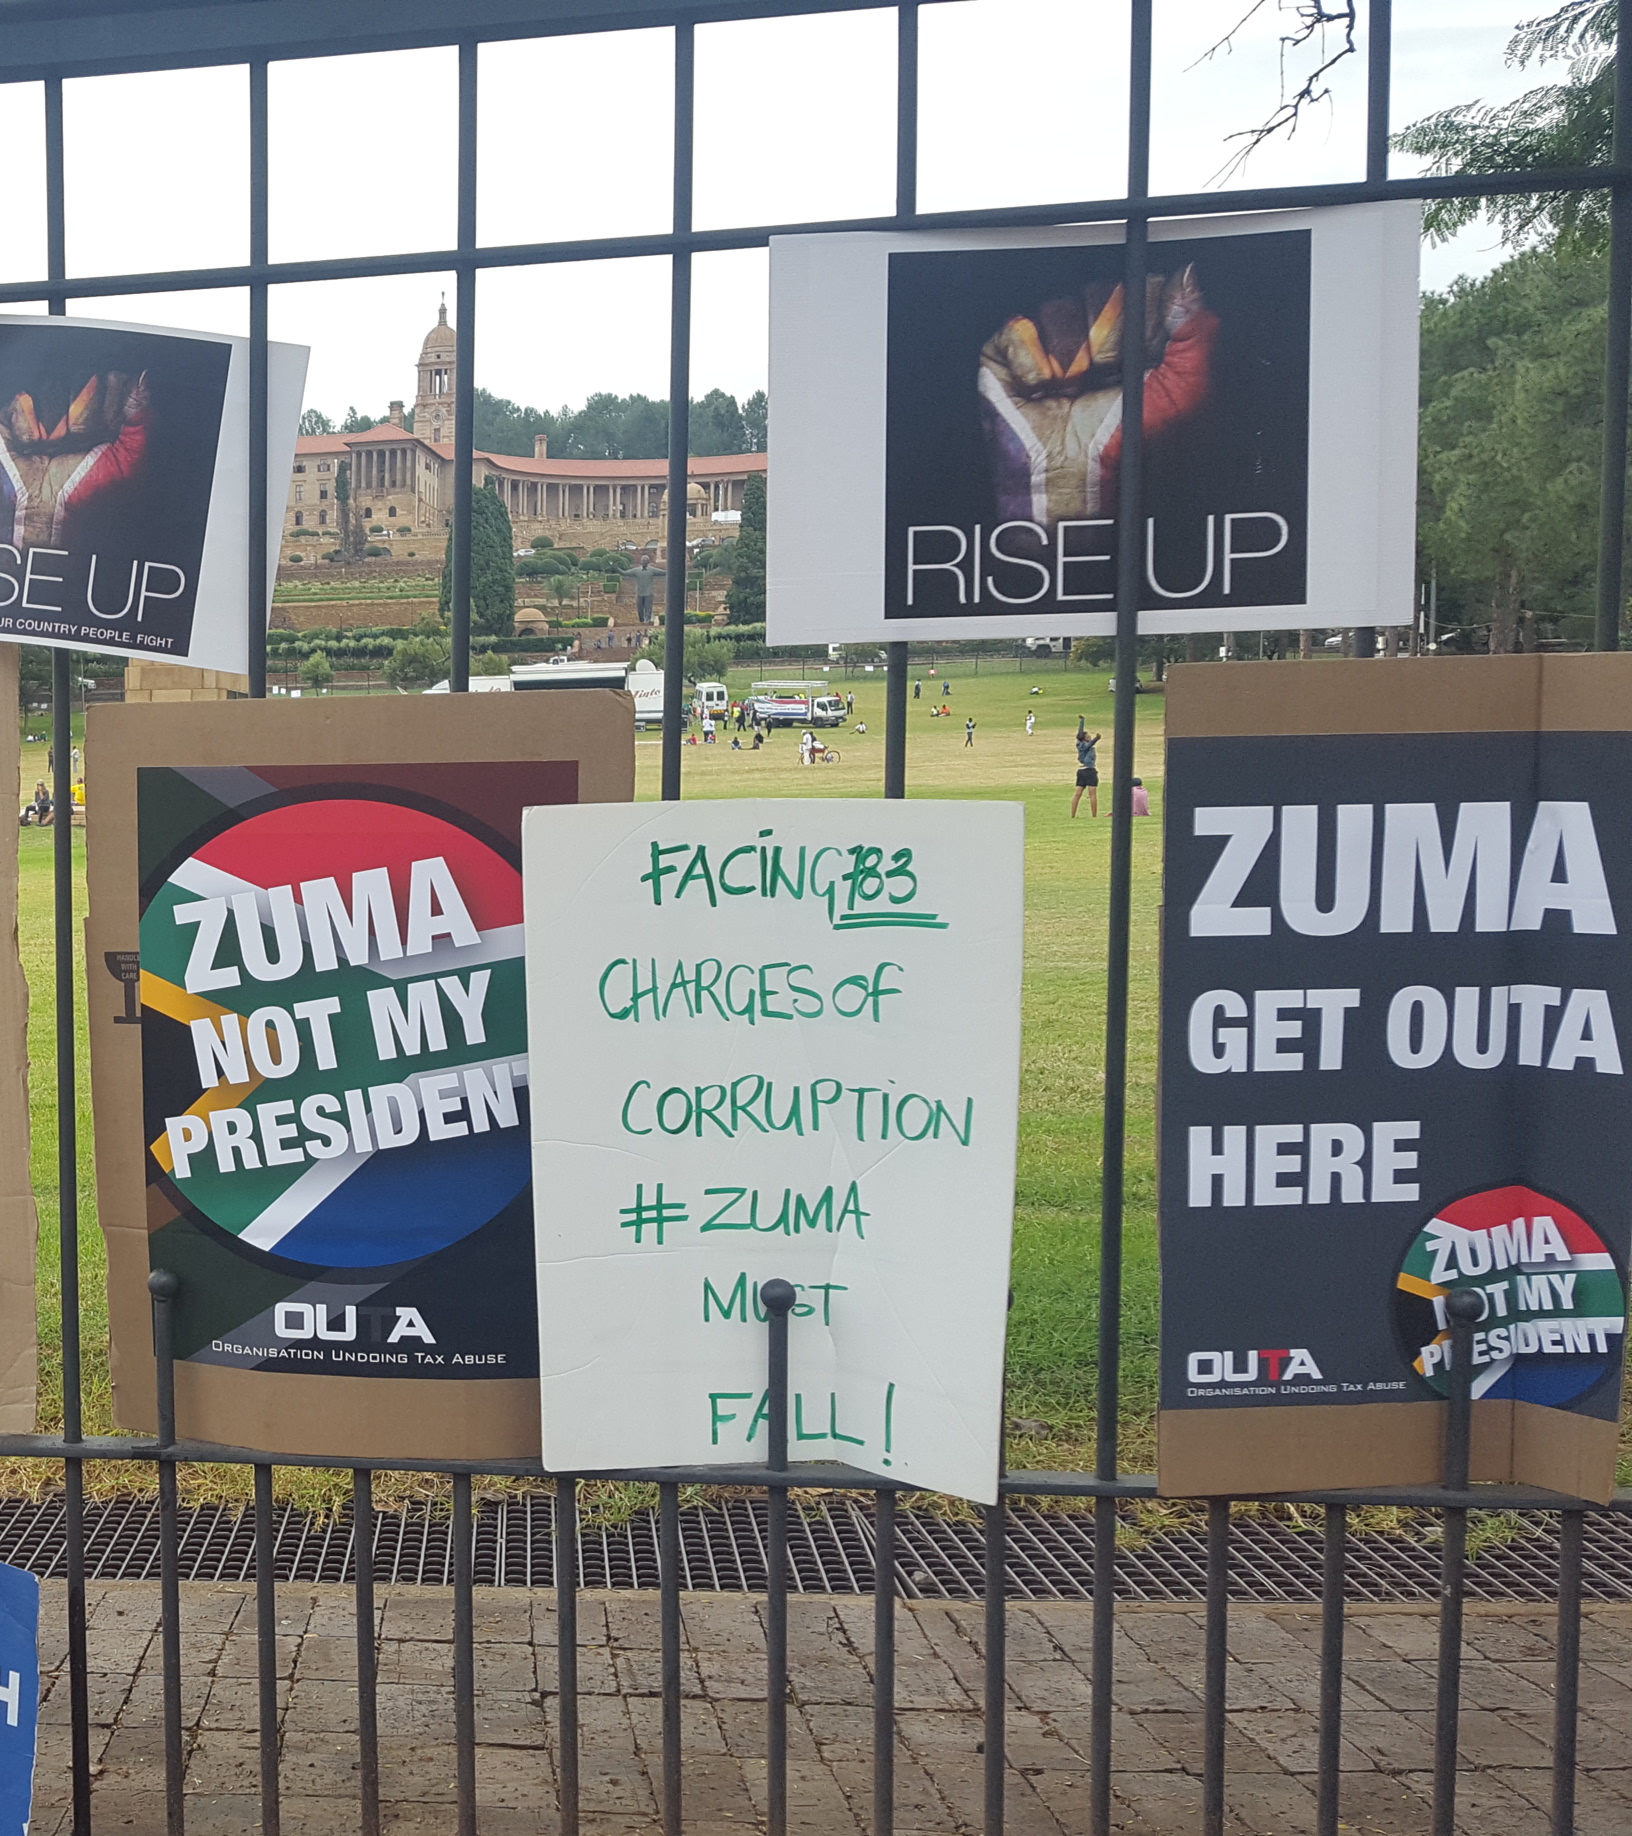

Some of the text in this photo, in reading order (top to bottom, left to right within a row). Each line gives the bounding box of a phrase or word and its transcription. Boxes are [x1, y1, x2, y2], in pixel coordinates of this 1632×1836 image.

[87, 554, 186, 622] UP
[907, 511, 1289, 605] RISE UP
[16, 618, 77, 636] COUNTRY
[81, 626, 133, 643] PEOPLE.
[137, 634, 174, 649] FIGHT
[1189, 801, 1617, 938] ZUMA
[172, 856, 482, 994] ZUMA
[189, 969, 492, 1089] NOT MY
[599, 957, 824, 1026] CHARGES
[1188, 984, 1624, 1075] GET OUTA
[165, 1059, 529, 1179] PRESIDEN
[1188, 1120, 1421, 1207] HERE
[1425, 1216, 1572, 1285] ZUMA
[1517, 1273, 1576, 1311] MY
[1187, 1349, 1324, 1383] OUTA
